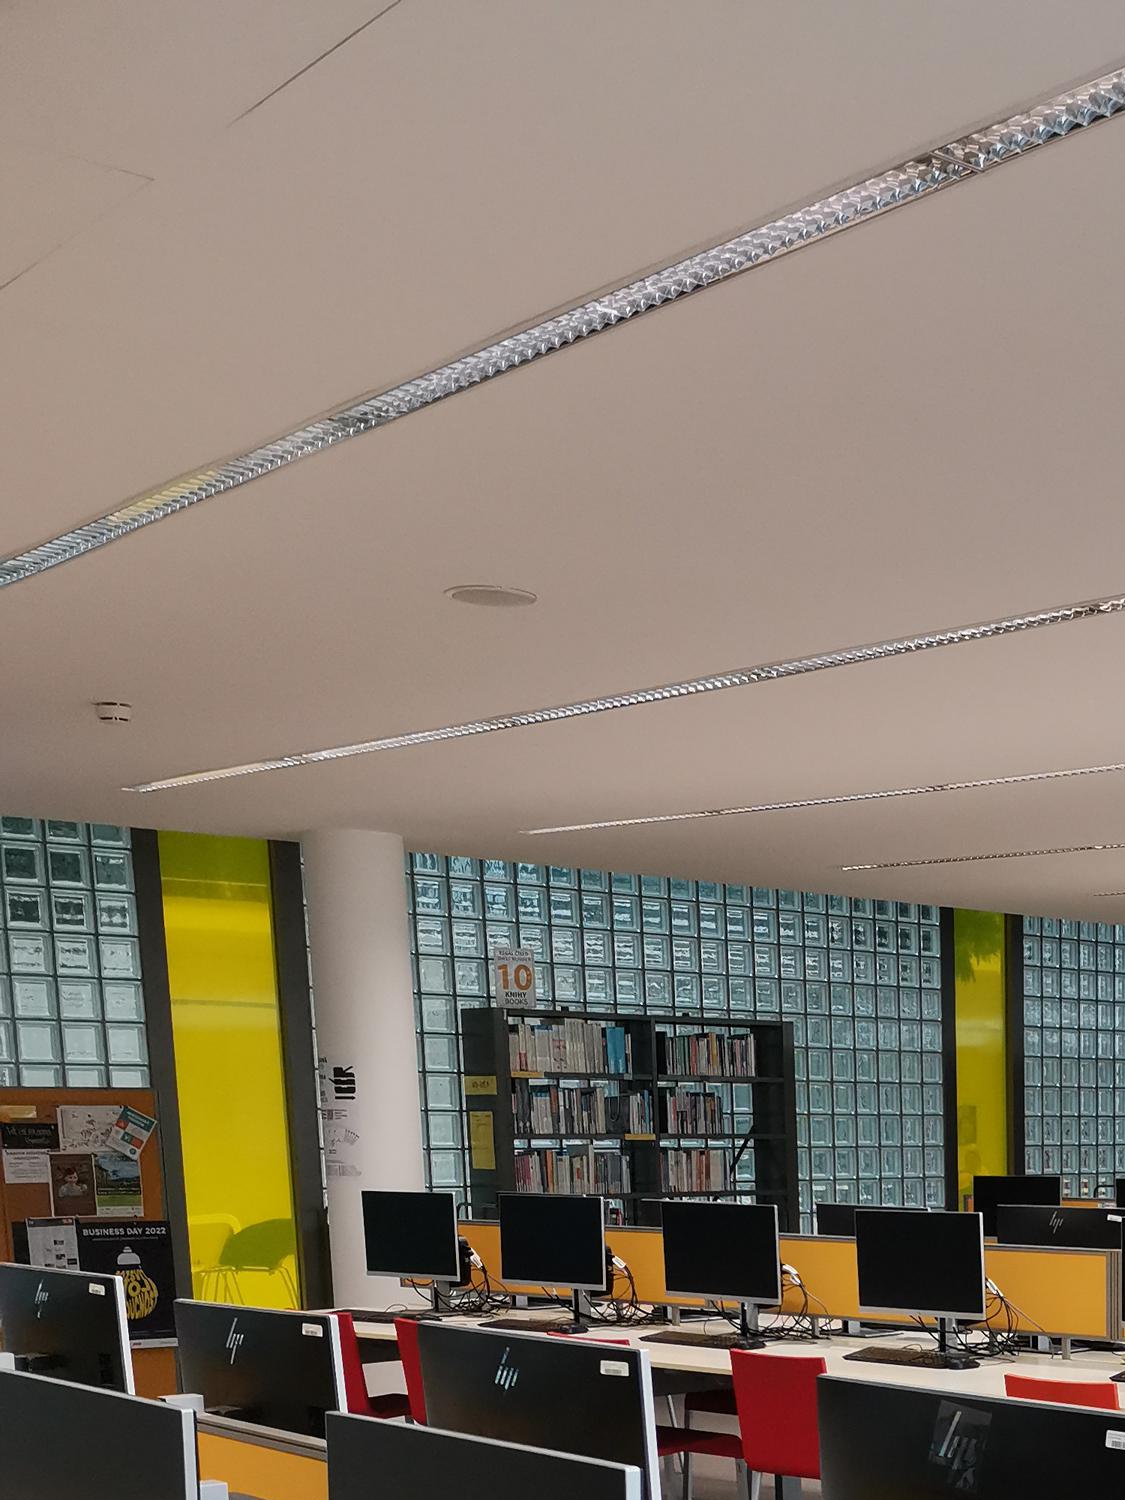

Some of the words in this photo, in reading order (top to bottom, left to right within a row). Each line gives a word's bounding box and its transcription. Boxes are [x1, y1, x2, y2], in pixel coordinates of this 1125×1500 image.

[498, 964, 532, 991] 10
[82, 1228, 125, 1236] BUSINESS
[126, 1227, 143, 1235] DAY
[145, 1227, 167, 1235] 2022
[1049, 1210, 1063, 1234] hp
[226, 1317, 244, 1365] hp
[494, 1346, 519, 1391] hp
